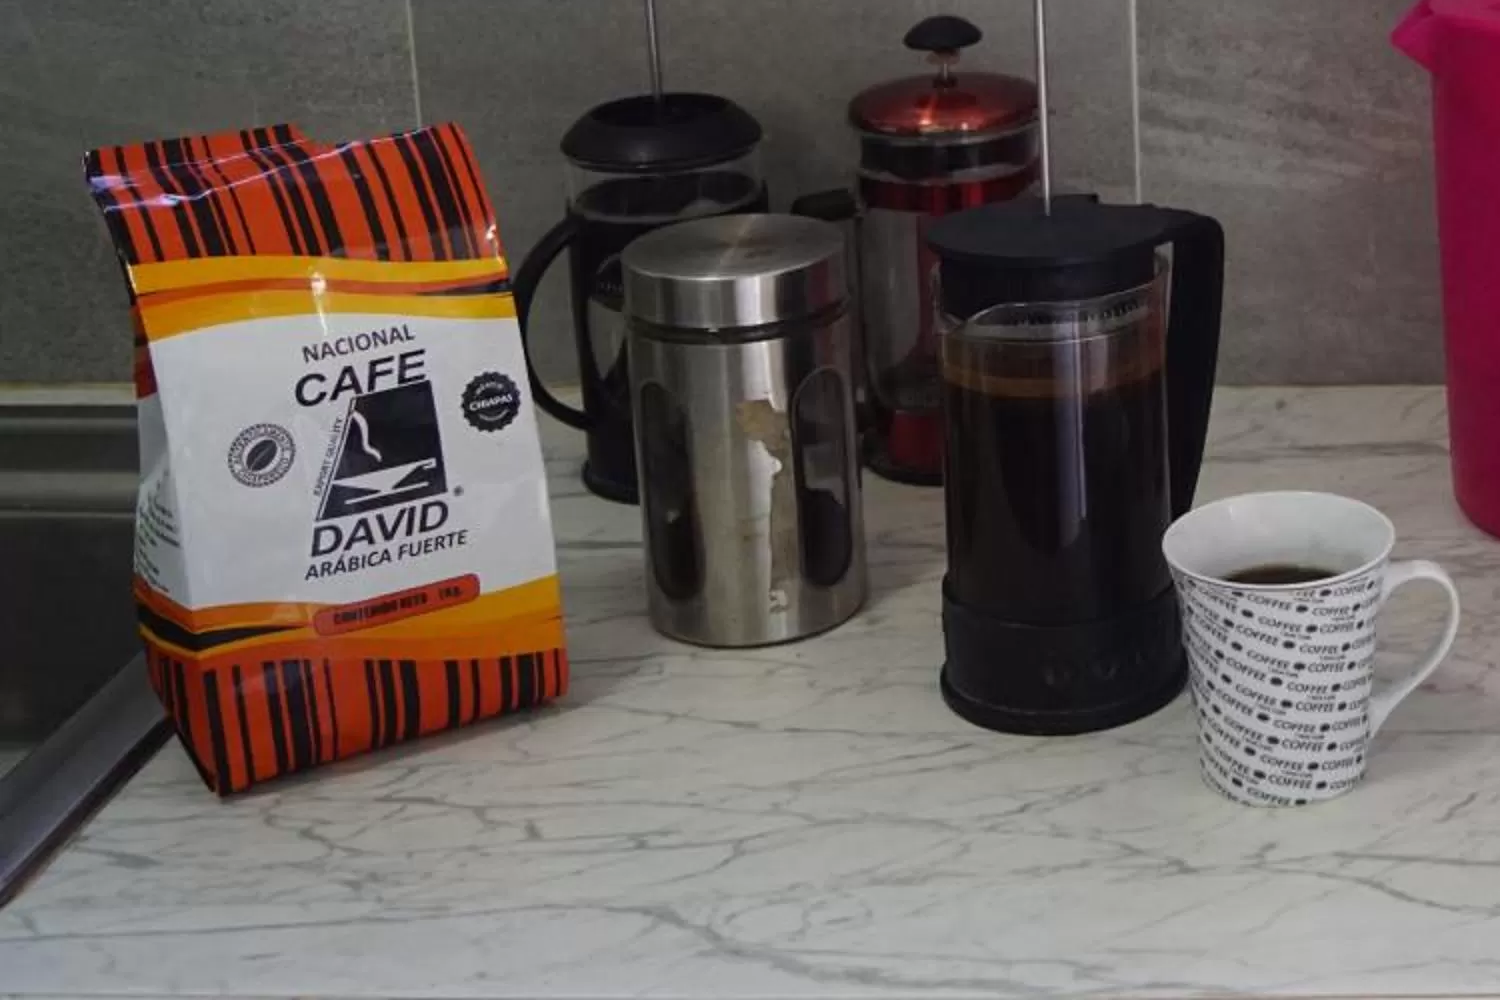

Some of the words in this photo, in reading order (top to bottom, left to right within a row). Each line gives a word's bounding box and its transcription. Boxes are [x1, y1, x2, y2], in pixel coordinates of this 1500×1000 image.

[302, 324, 416, 364] NACIONAL
[294, 348, 426, 408] CAFE
[310, 501, 449, 558] DAVID
[304, 549, 392, 581] ARÁBICA
[397, 529, 469, 561] FUERTE
[1247, 593, 1291, 611] COFFEE
[1312, 606, 1350, 617] COFFEE
[1236, 624, 1278, 647] COFFEE
[1299, 645, 1338, 655] COFFEE
[1258, 615, 1301, 632] COFFEE
[1320, 621, 1354, 634] COFFEE
[1226, 656, 1266, 681] COFFEE
[1287, 682, 1328, 694] COFFEE
[1247, 650, 1290, 669] COFFEE
[1308, 662, 1345, 673] COFFEE
[1216, 688, 1253, 716] COFFEE
[1273, 719, 1316, 733] COFFEE
[1236, 683, 1277, 706] COFFEE
[1296, 701, 1335, 713] COFFEE
[1223, 715, 1263, 741] COFFEE
[1281, 739, 1324, 752] COFFEE
[1214, 745, 1249, 774] COFFEE
[1268, 774, 1312, 789] COFFEE
[1260, 754, 1303, 770] COFFEE
[1322, 756, 1353, 770] COFFEE
[1247, 787, 1290, 805] COFFEE
